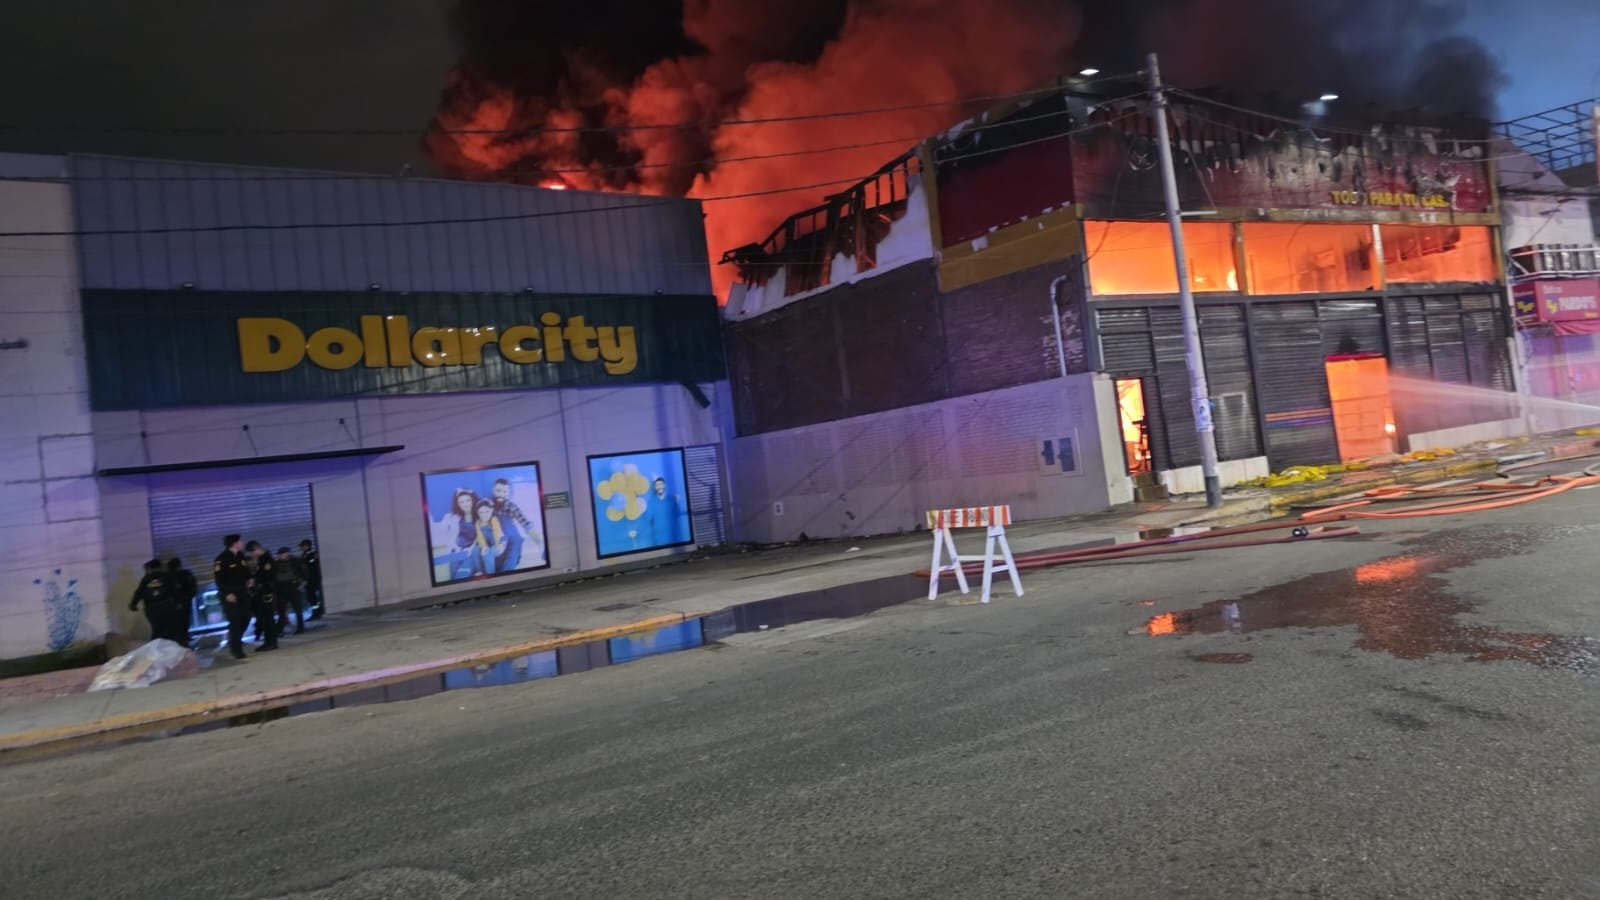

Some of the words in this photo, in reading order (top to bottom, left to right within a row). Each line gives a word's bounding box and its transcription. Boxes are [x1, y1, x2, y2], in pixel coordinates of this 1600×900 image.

[1368, 192, 1401, 207] PARA
[1421, 195, 1450, 208] CAS
[237, 312, 638, 375] Dollarcity
